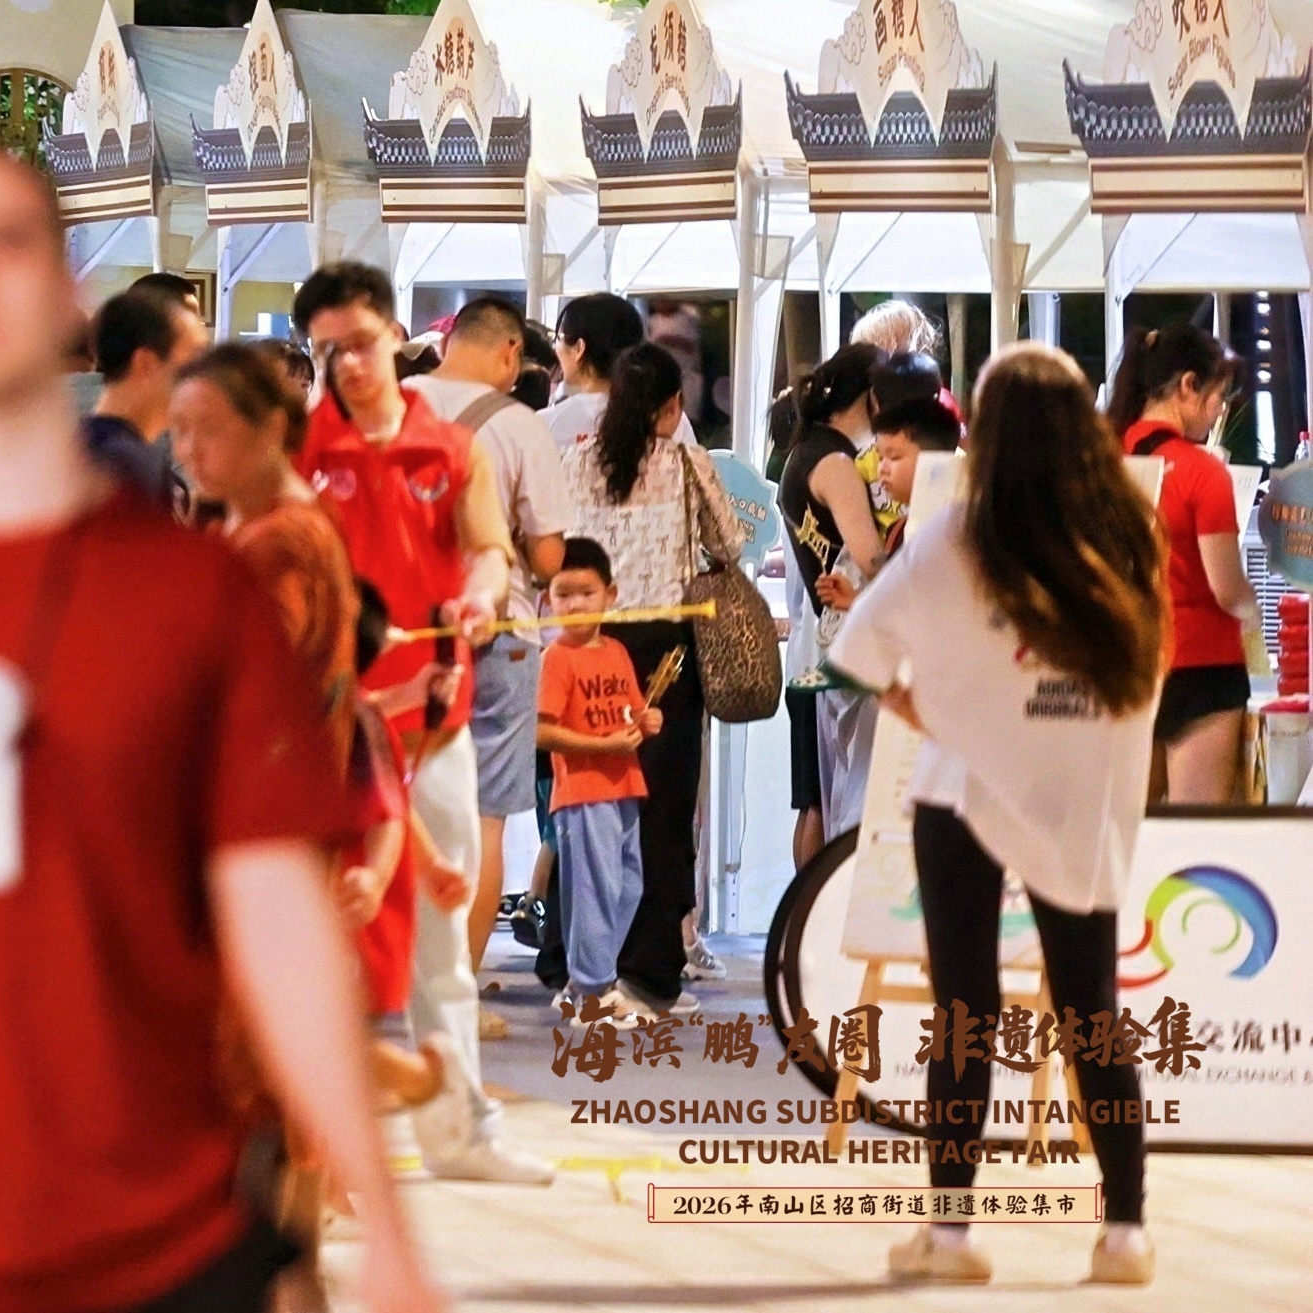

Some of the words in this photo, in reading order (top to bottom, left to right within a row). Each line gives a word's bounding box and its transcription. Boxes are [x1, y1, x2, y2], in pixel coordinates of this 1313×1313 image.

[432, 27, 475, 86] 冰糖葫芦
[650, 10, 688, 75] 龙须糖
[1167, 51, 1188, 101] Sugar
